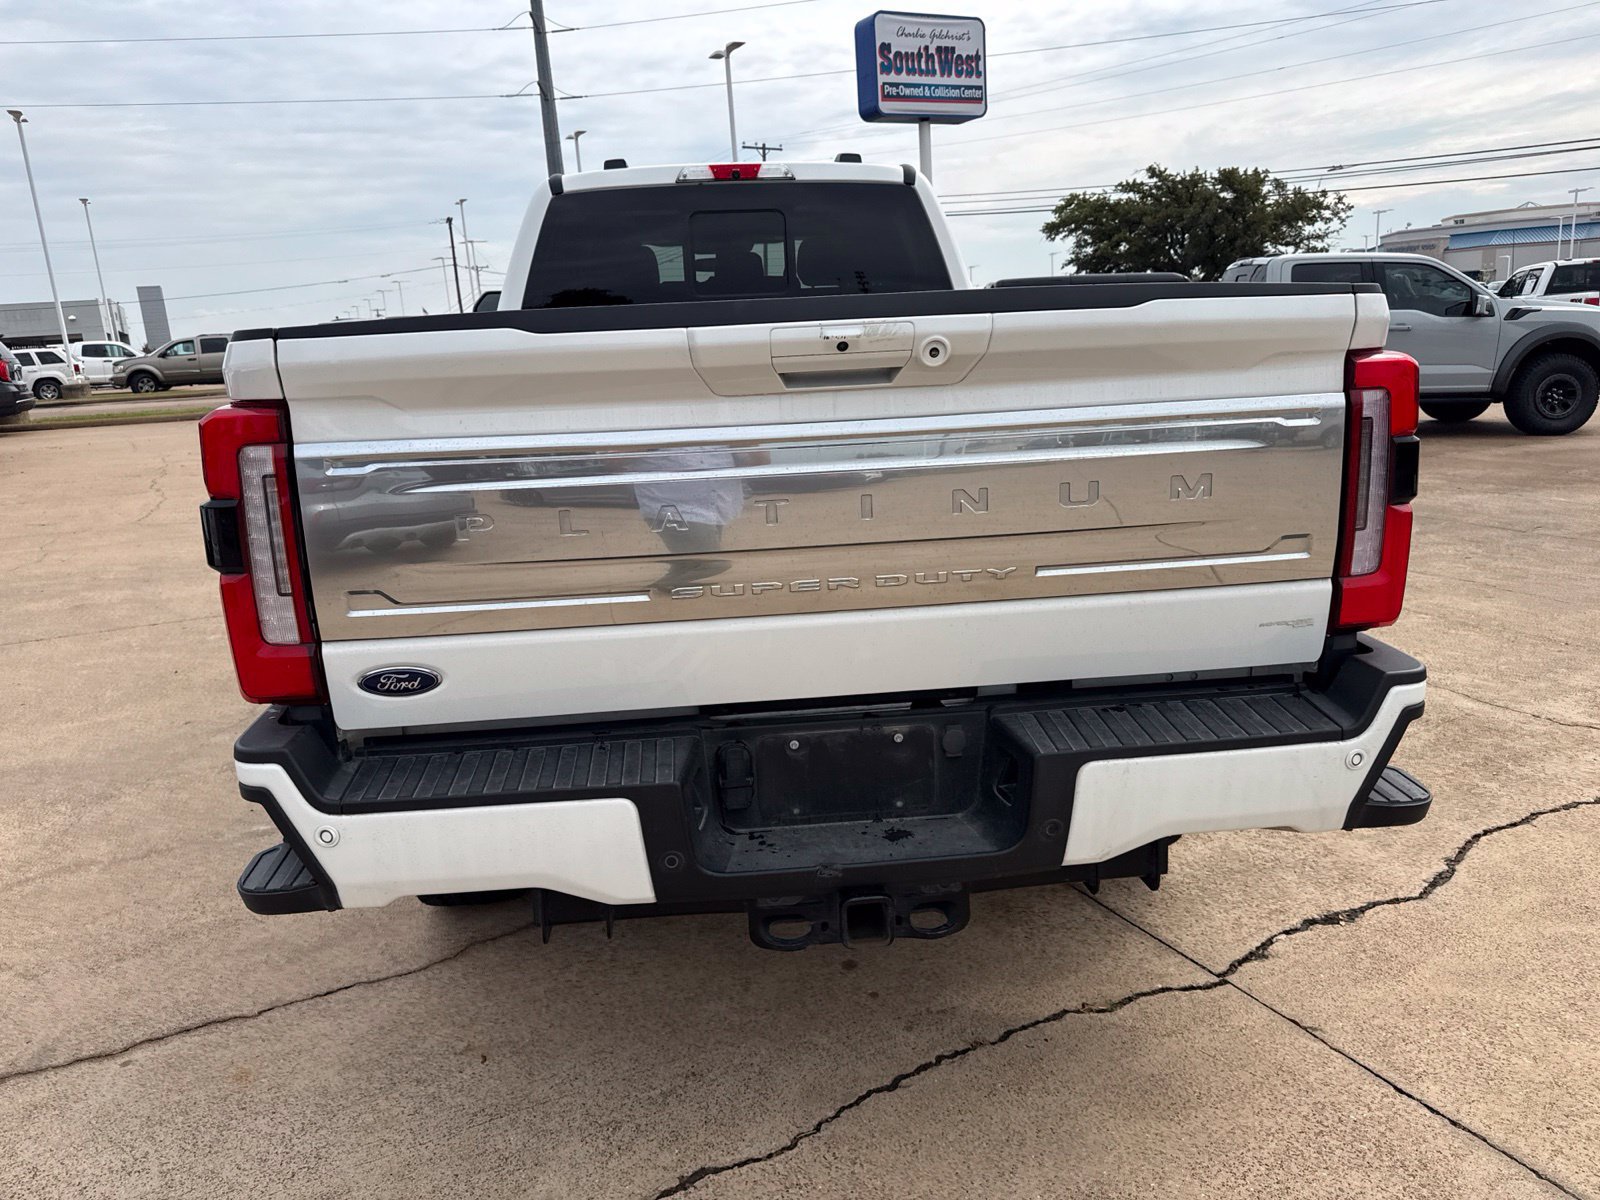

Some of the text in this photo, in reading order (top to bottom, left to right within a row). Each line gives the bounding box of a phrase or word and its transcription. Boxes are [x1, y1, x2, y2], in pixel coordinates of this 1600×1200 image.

[896, 26, 971, 44] Charlie Gilchrist's
[878, 41, 983, 78] SouthWest
[884, 84, 982, 98] Pre-Owned & Collision Center
[454, 472, 1213, 542] PLATINUM
[671, 566, 1017, 600] SUPER DUTY
[377, 673, 421, 690] Ford
